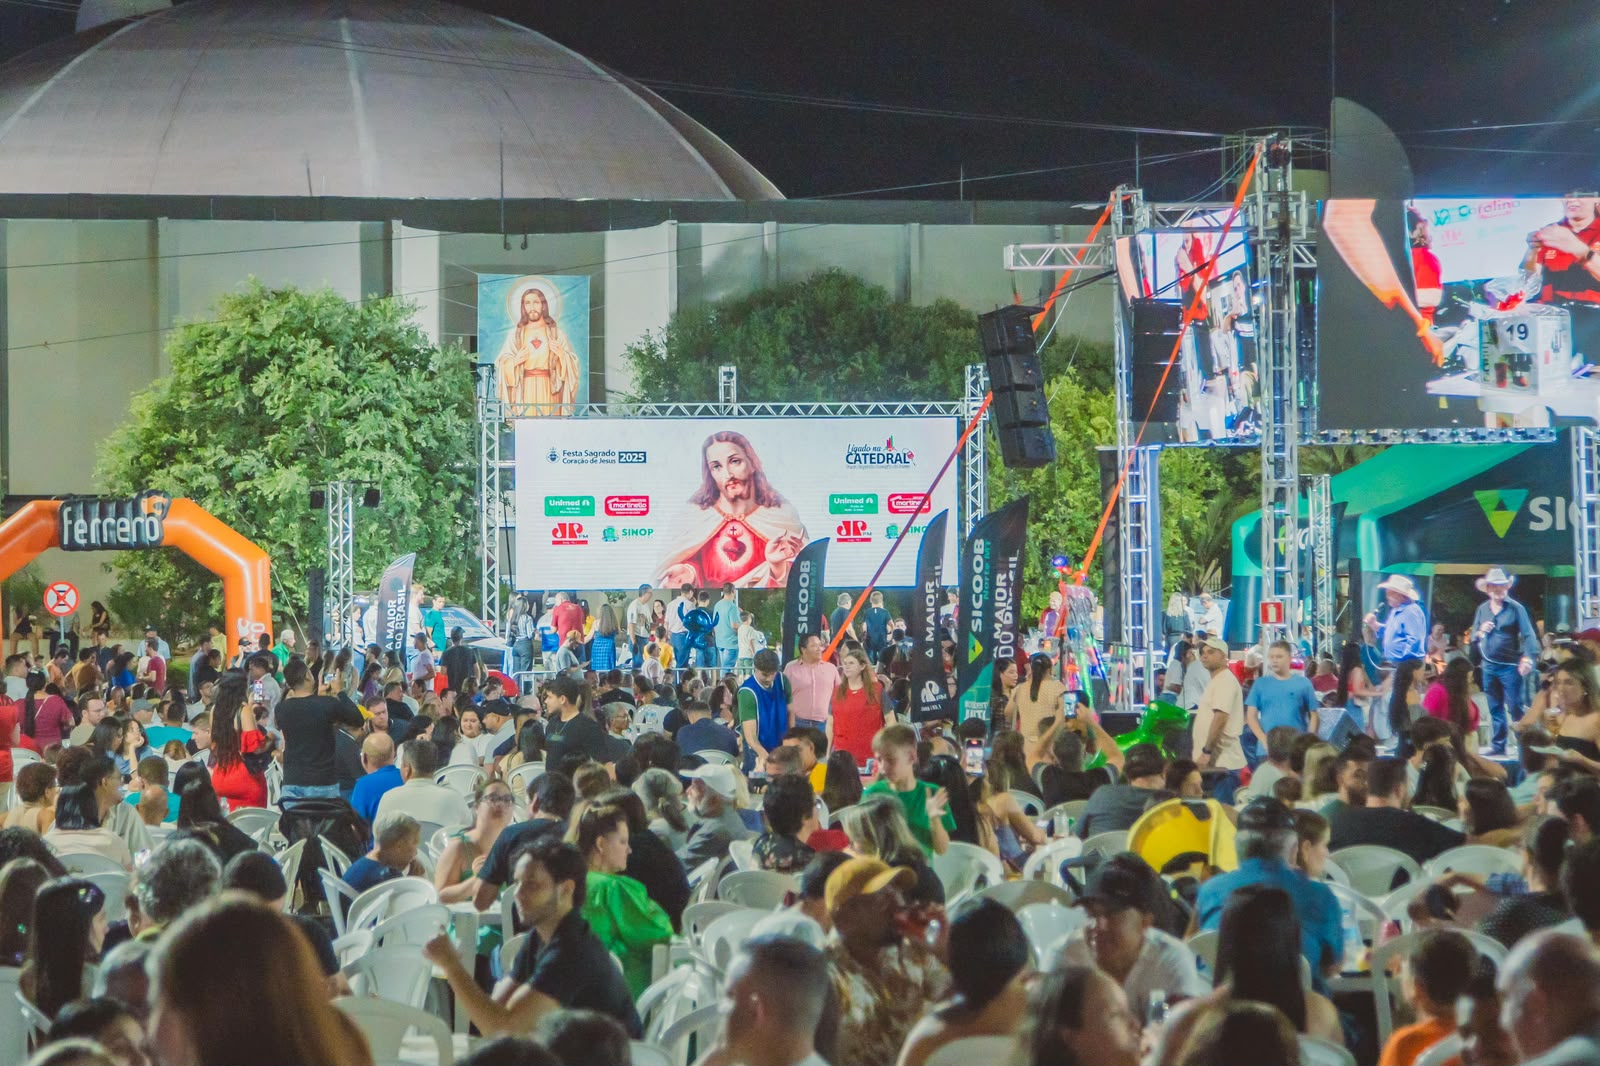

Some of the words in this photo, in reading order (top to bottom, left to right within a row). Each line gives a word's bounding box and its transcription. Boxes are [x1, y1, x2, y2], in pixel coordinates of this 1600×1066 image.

[1506, 323, 1529, 341] 19
[585, 450, 616, 459] Sagrado
[847, 443, 871, 455] Ligado
[620, 453, 645, 462] 2025
[846, 453, 910, 465] CATEDRAL
[63, 506, 160, 545] ferrero
[552, 523, 583, 538] JP
[622, 528, 654, 536] SINOP
[837, 520, 867, 536] JP
[971, 538, 985, 633] SICOOB
[797, 560, 811, 634] SICOOB
[396, 584, 406, 630] BRASIL
[925, 580, 936, 642] MAIOR
[386, 599, 397, 639] MAIOR
[385, 641, 394, 650] A
[394, 634, 403, 650] DO
[999, 631, 1014, 658] DO
[925, 647, 934, 658] A
